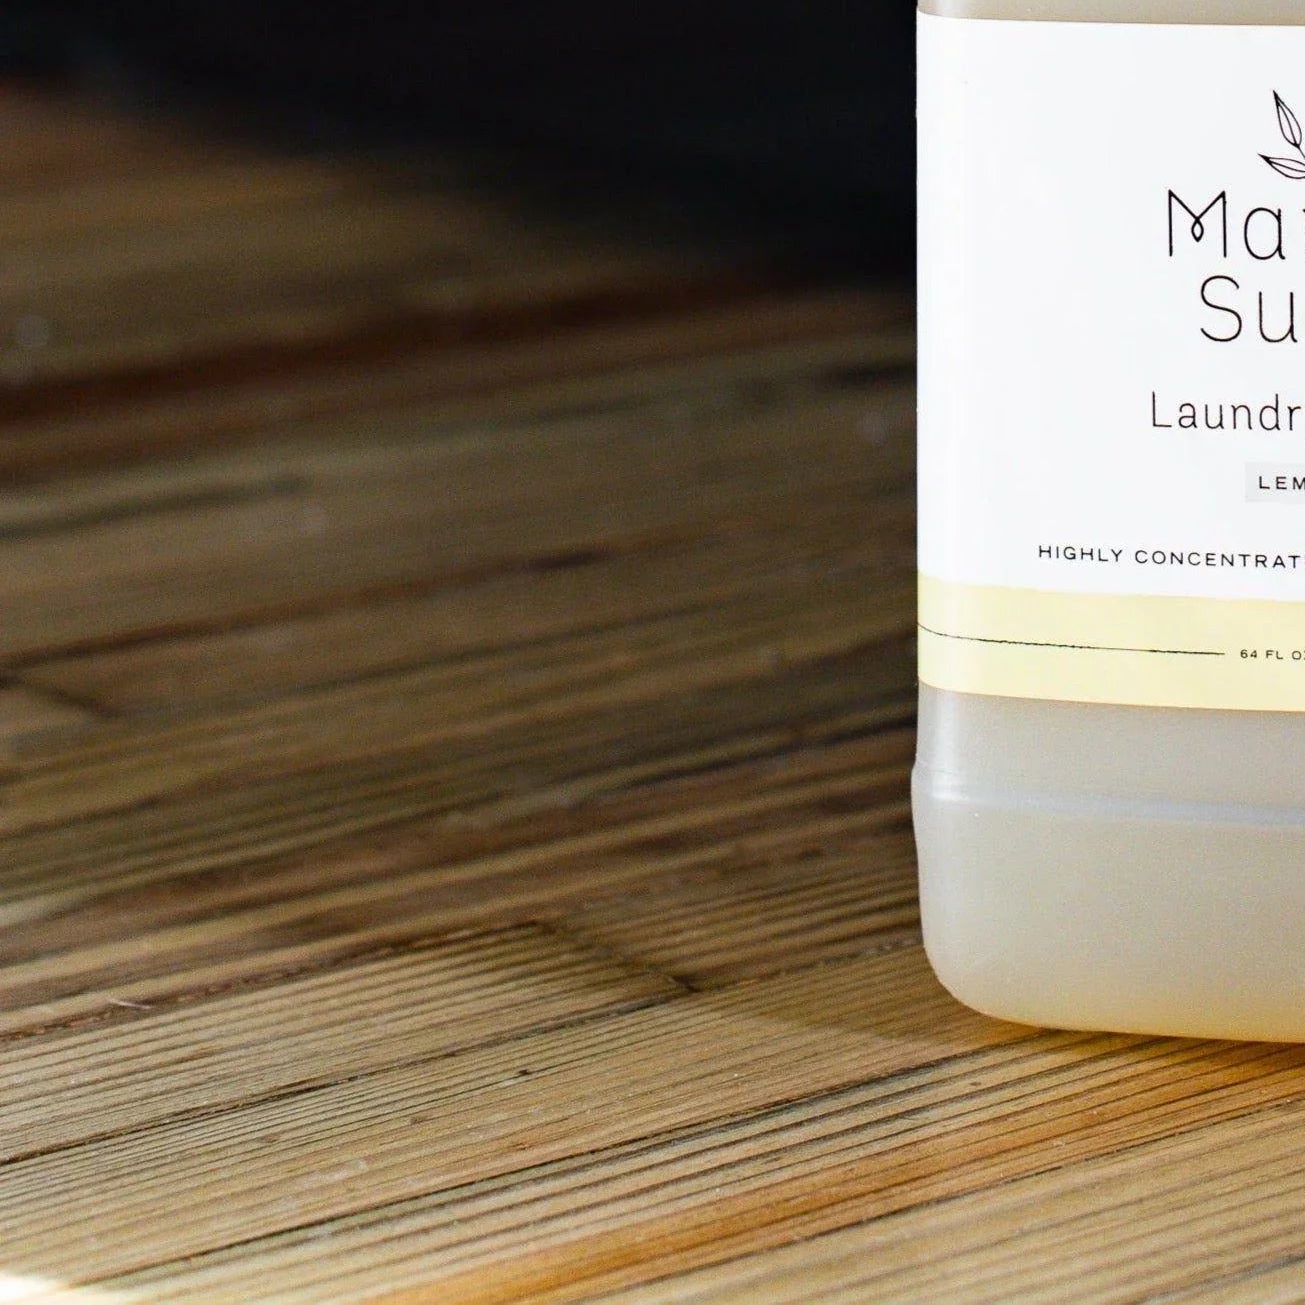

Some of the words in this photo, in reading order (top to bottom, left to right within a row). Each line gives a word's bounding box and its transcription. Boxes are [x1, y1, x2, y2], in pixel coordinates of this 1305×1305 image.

[1038, 544, 1123, 564] HIGHLY
[1239, 648, 1258, 660] 64
[1265, 649, 1284, 660] FL
